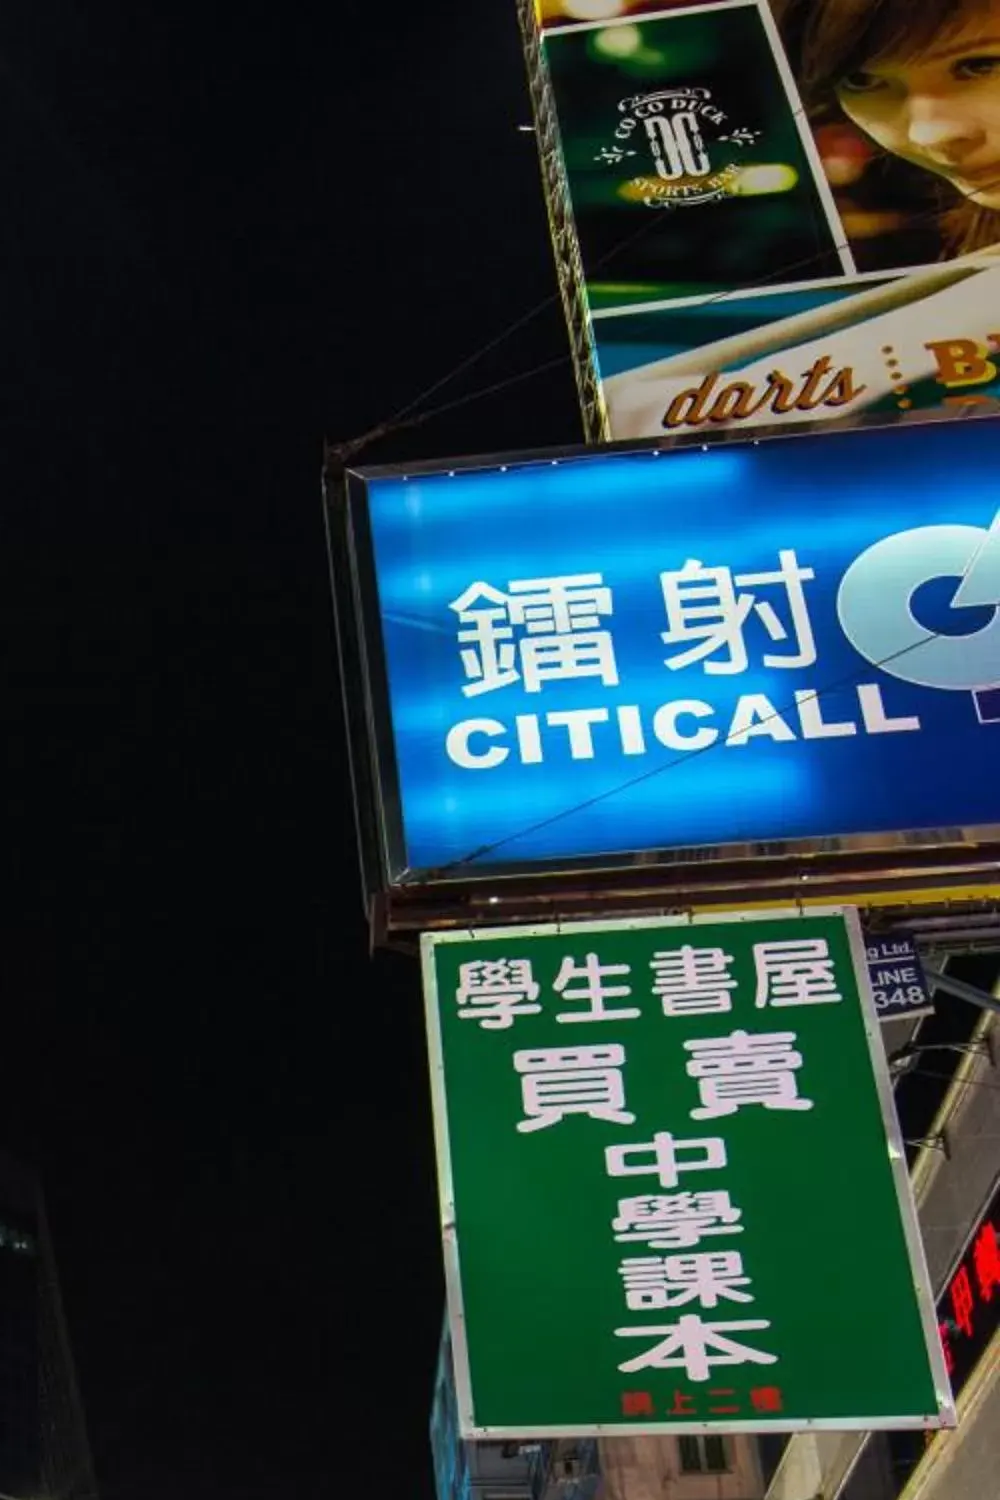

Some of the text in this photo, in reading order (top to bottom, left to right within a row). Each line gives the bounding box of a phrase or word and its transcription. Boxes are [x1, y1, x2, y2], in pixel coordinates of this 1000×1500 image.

[662, 354, 867, 428] darts
[449, 549, 817, 699] 鐳射
[445, 683, 921, 770] CITICALL
[456, 938, 843, 1030] 學生書屋
[881, 941, 915, 956] Ltd.
[513, 1029, 814, 1133] 買賣
[604, 1131, 778, 1382] 中學課本
